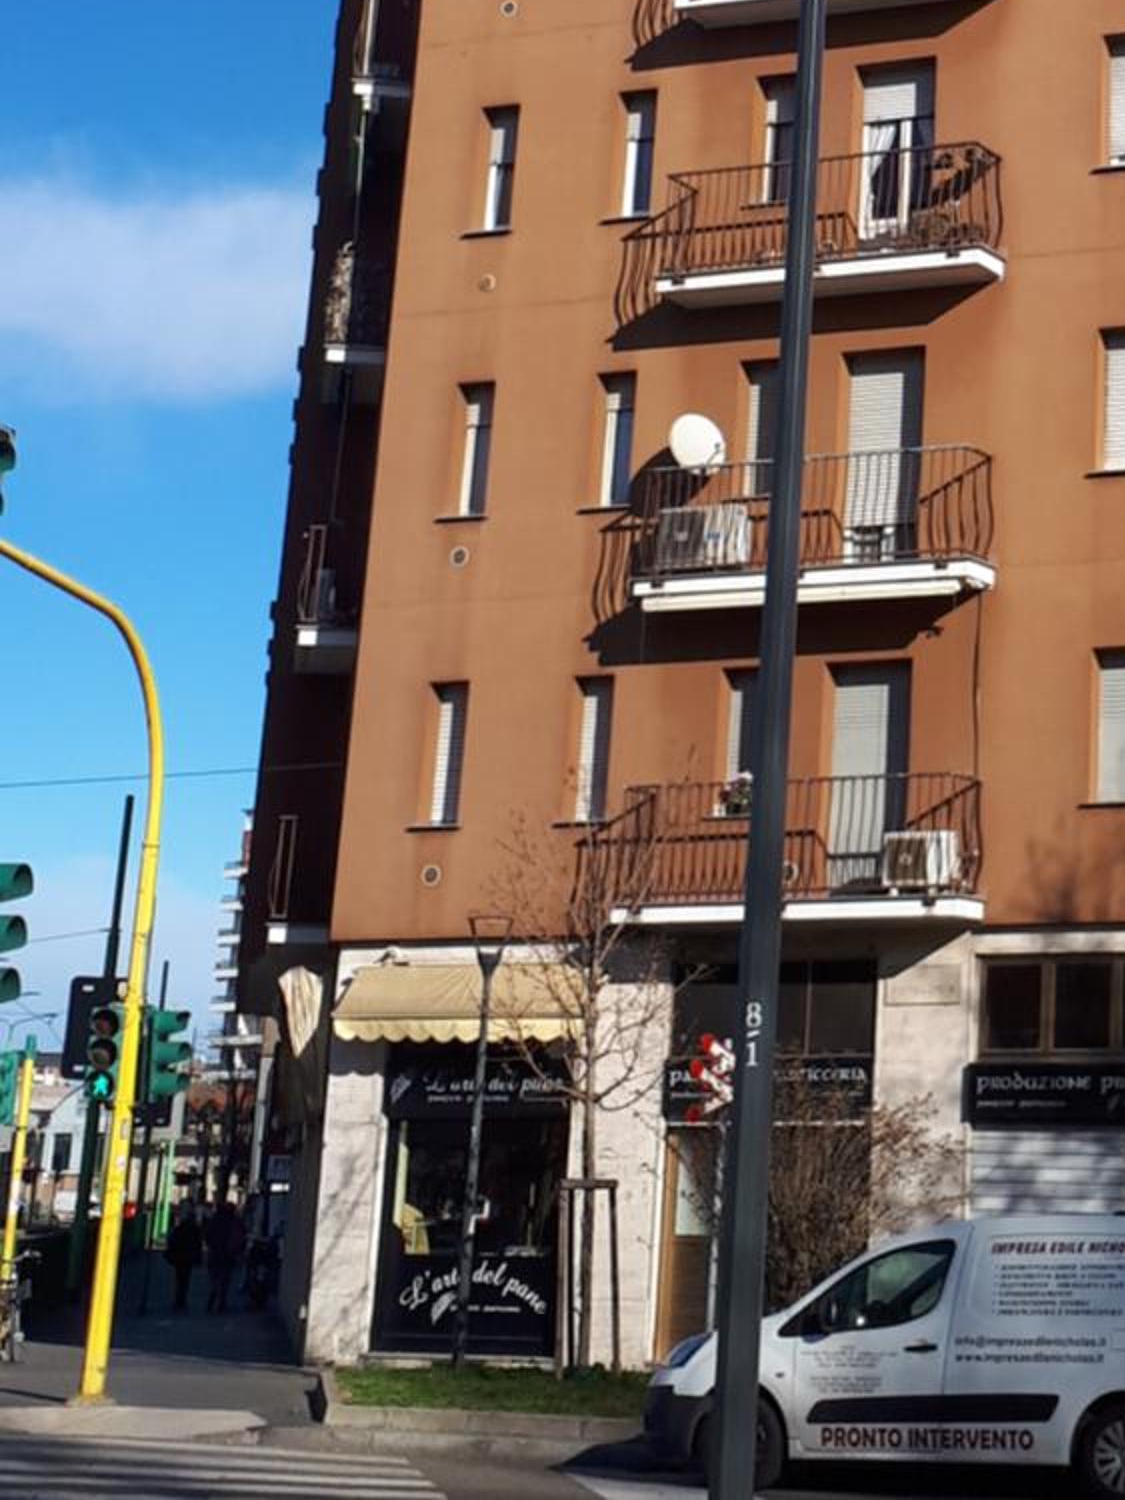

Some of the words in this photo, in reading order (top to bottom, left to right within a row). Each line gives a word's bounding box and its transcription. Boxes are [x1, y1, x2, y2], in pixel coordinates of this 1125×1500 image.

[471, 1250, 507, 1286] del
[501, 1277, 547, 1315] pane
[820, 1427, 902, 1448] PRONTO
[907, 1428, 1034, 1450] INTERVENTO
